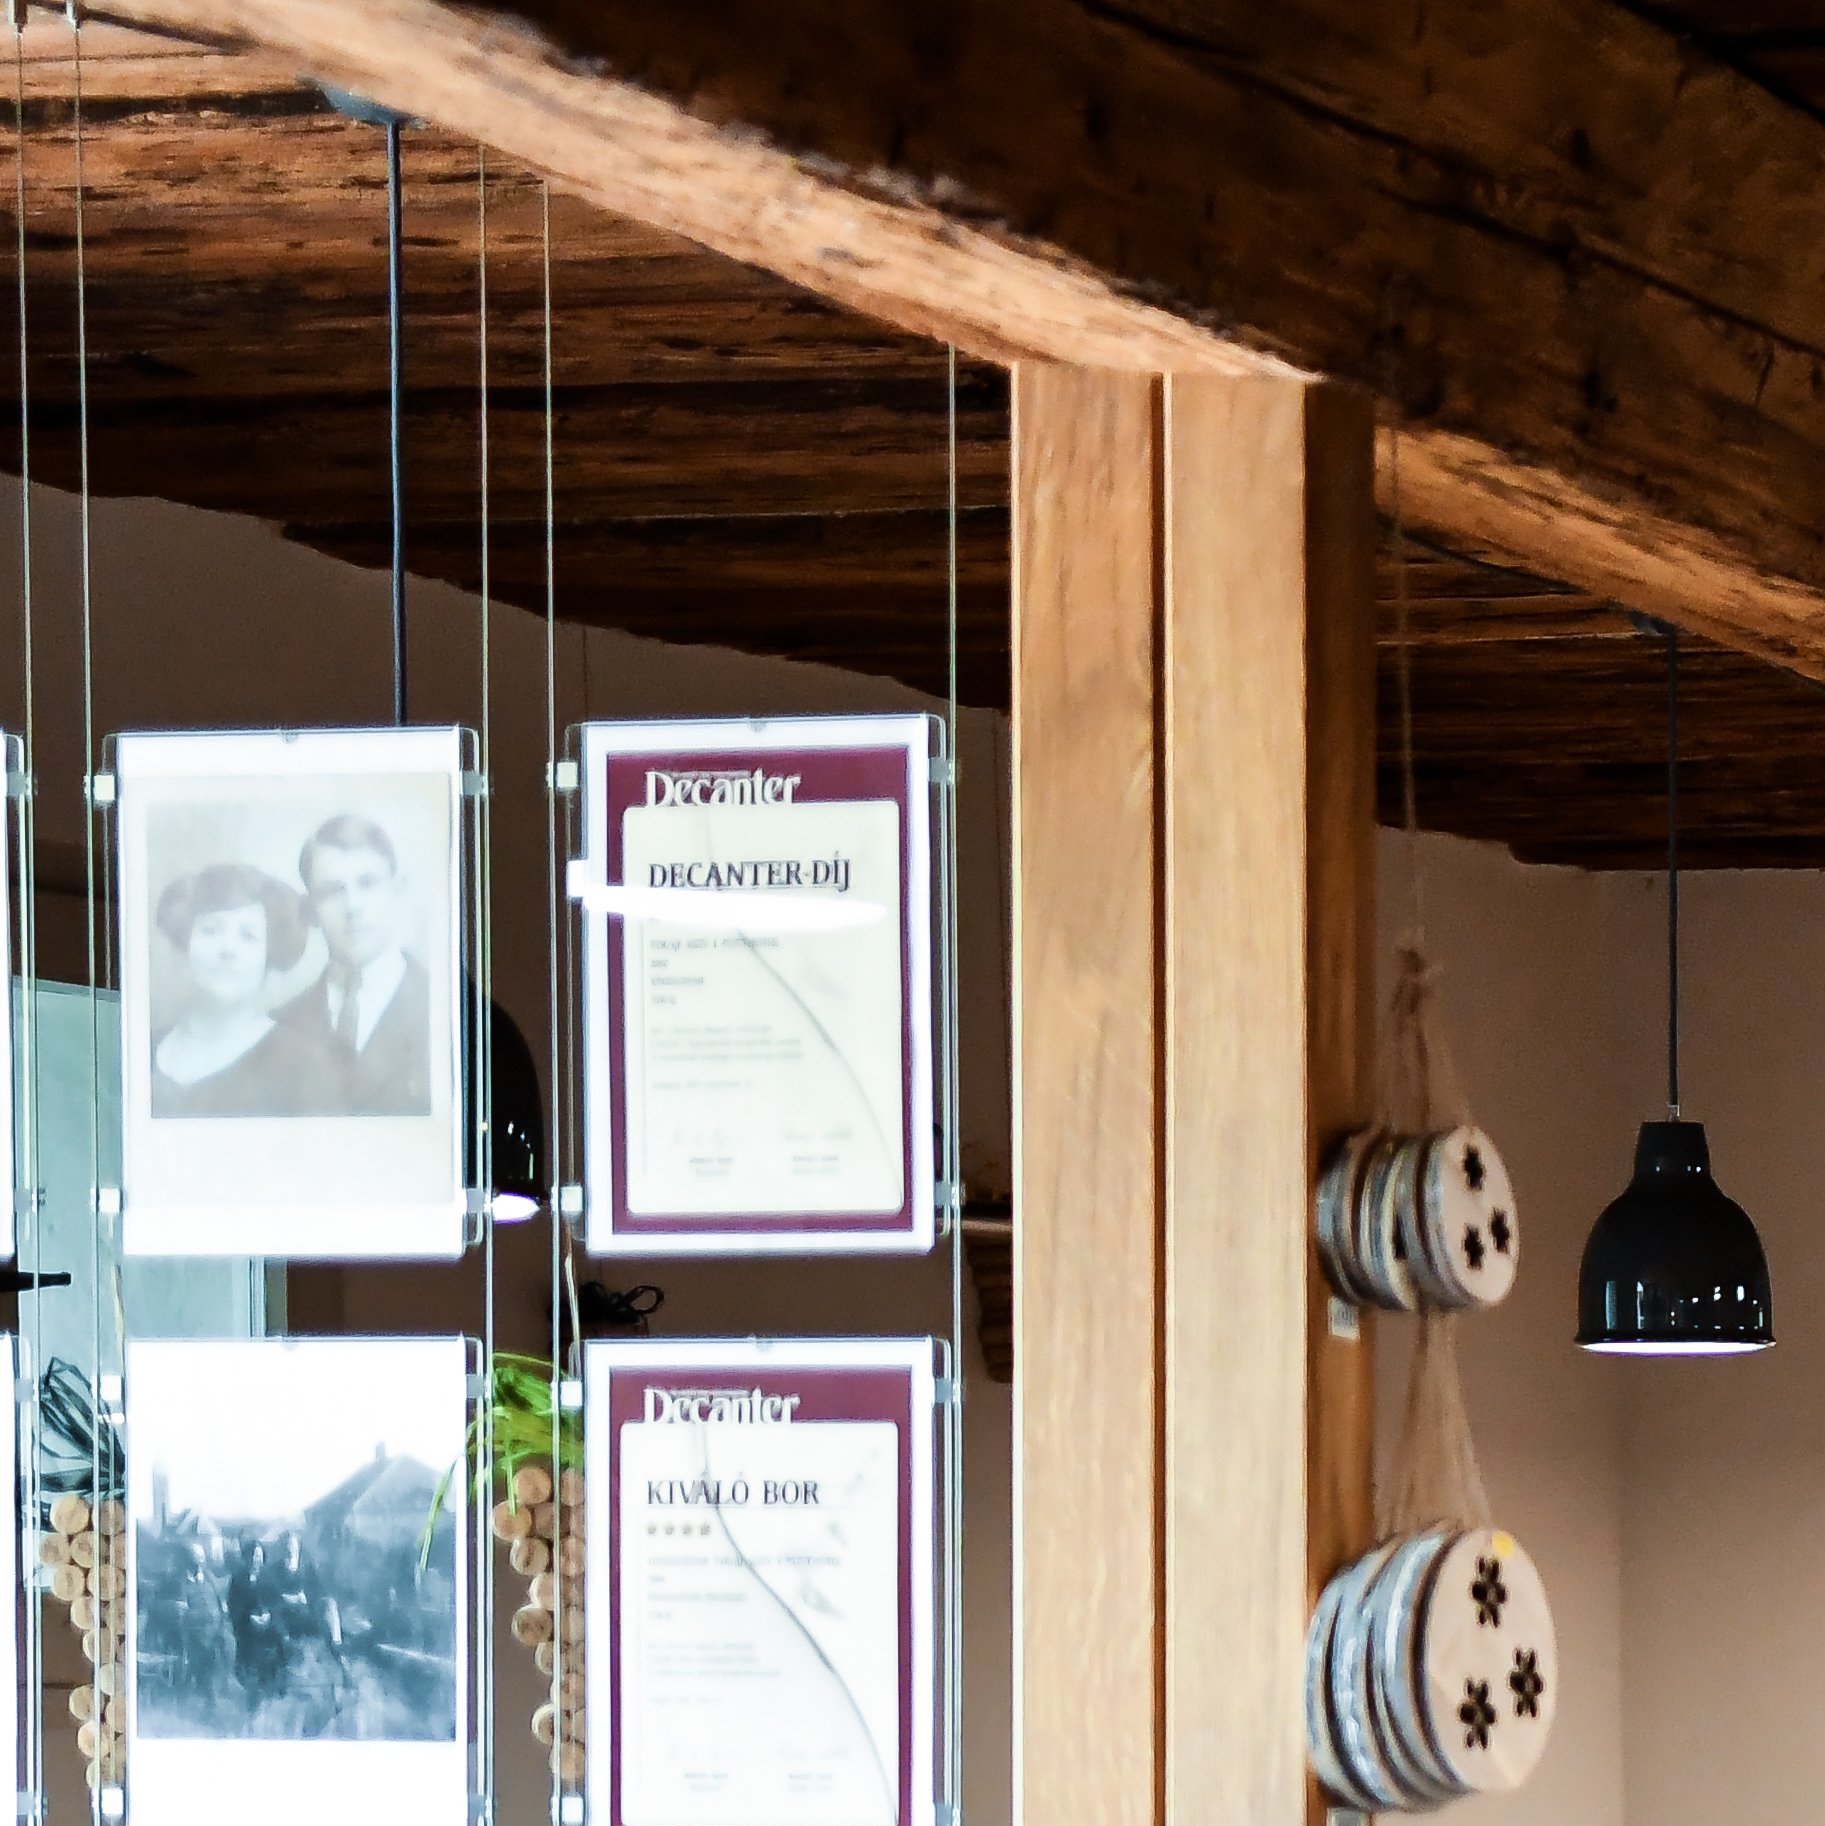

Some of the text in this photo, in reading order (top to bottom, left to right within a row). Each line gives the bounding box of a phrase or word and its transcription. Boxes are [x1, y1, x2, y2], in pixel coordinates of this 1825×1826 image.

[645, 768, 802, 807] Decanter
[643, 1385, 801, 1424] Decanter
[647, 1471, 820, 1506] KIVÁLÓ BOR
